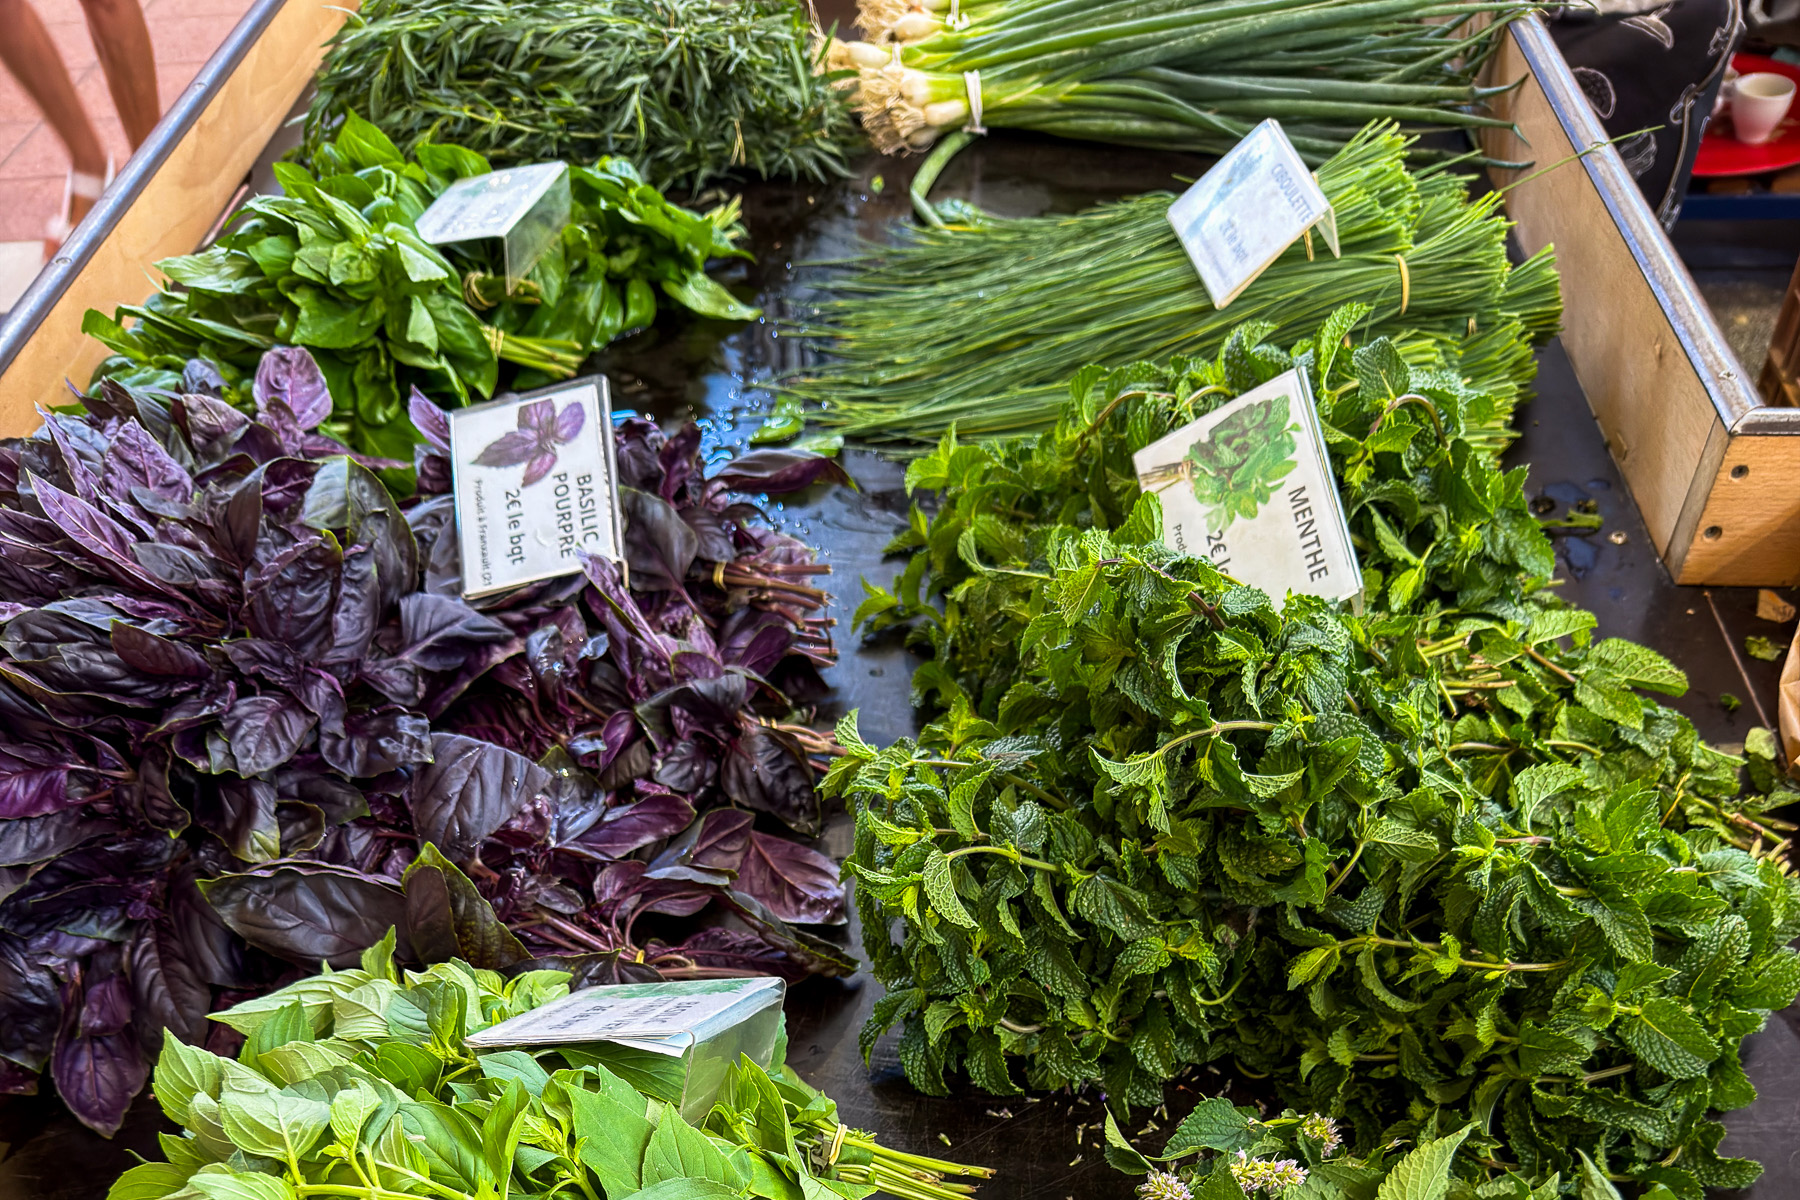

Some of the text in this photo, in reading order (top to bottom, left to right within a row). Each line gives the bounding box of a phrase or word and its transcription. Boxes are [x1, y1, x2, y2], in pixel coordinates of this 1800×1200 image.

[1270, 162, 1315, 224] CIBOULETTE
[505, 489, 526, 565] 2€ le bqt
[552, 472, 575, 558] POURPRE
[576, 474, 599, 544] BASILIC
[1173, 523, 1188, 553] Prod
[1206, 529, 1227, 557] 2€
[1288, 485, 1328, 583] MENTHE
